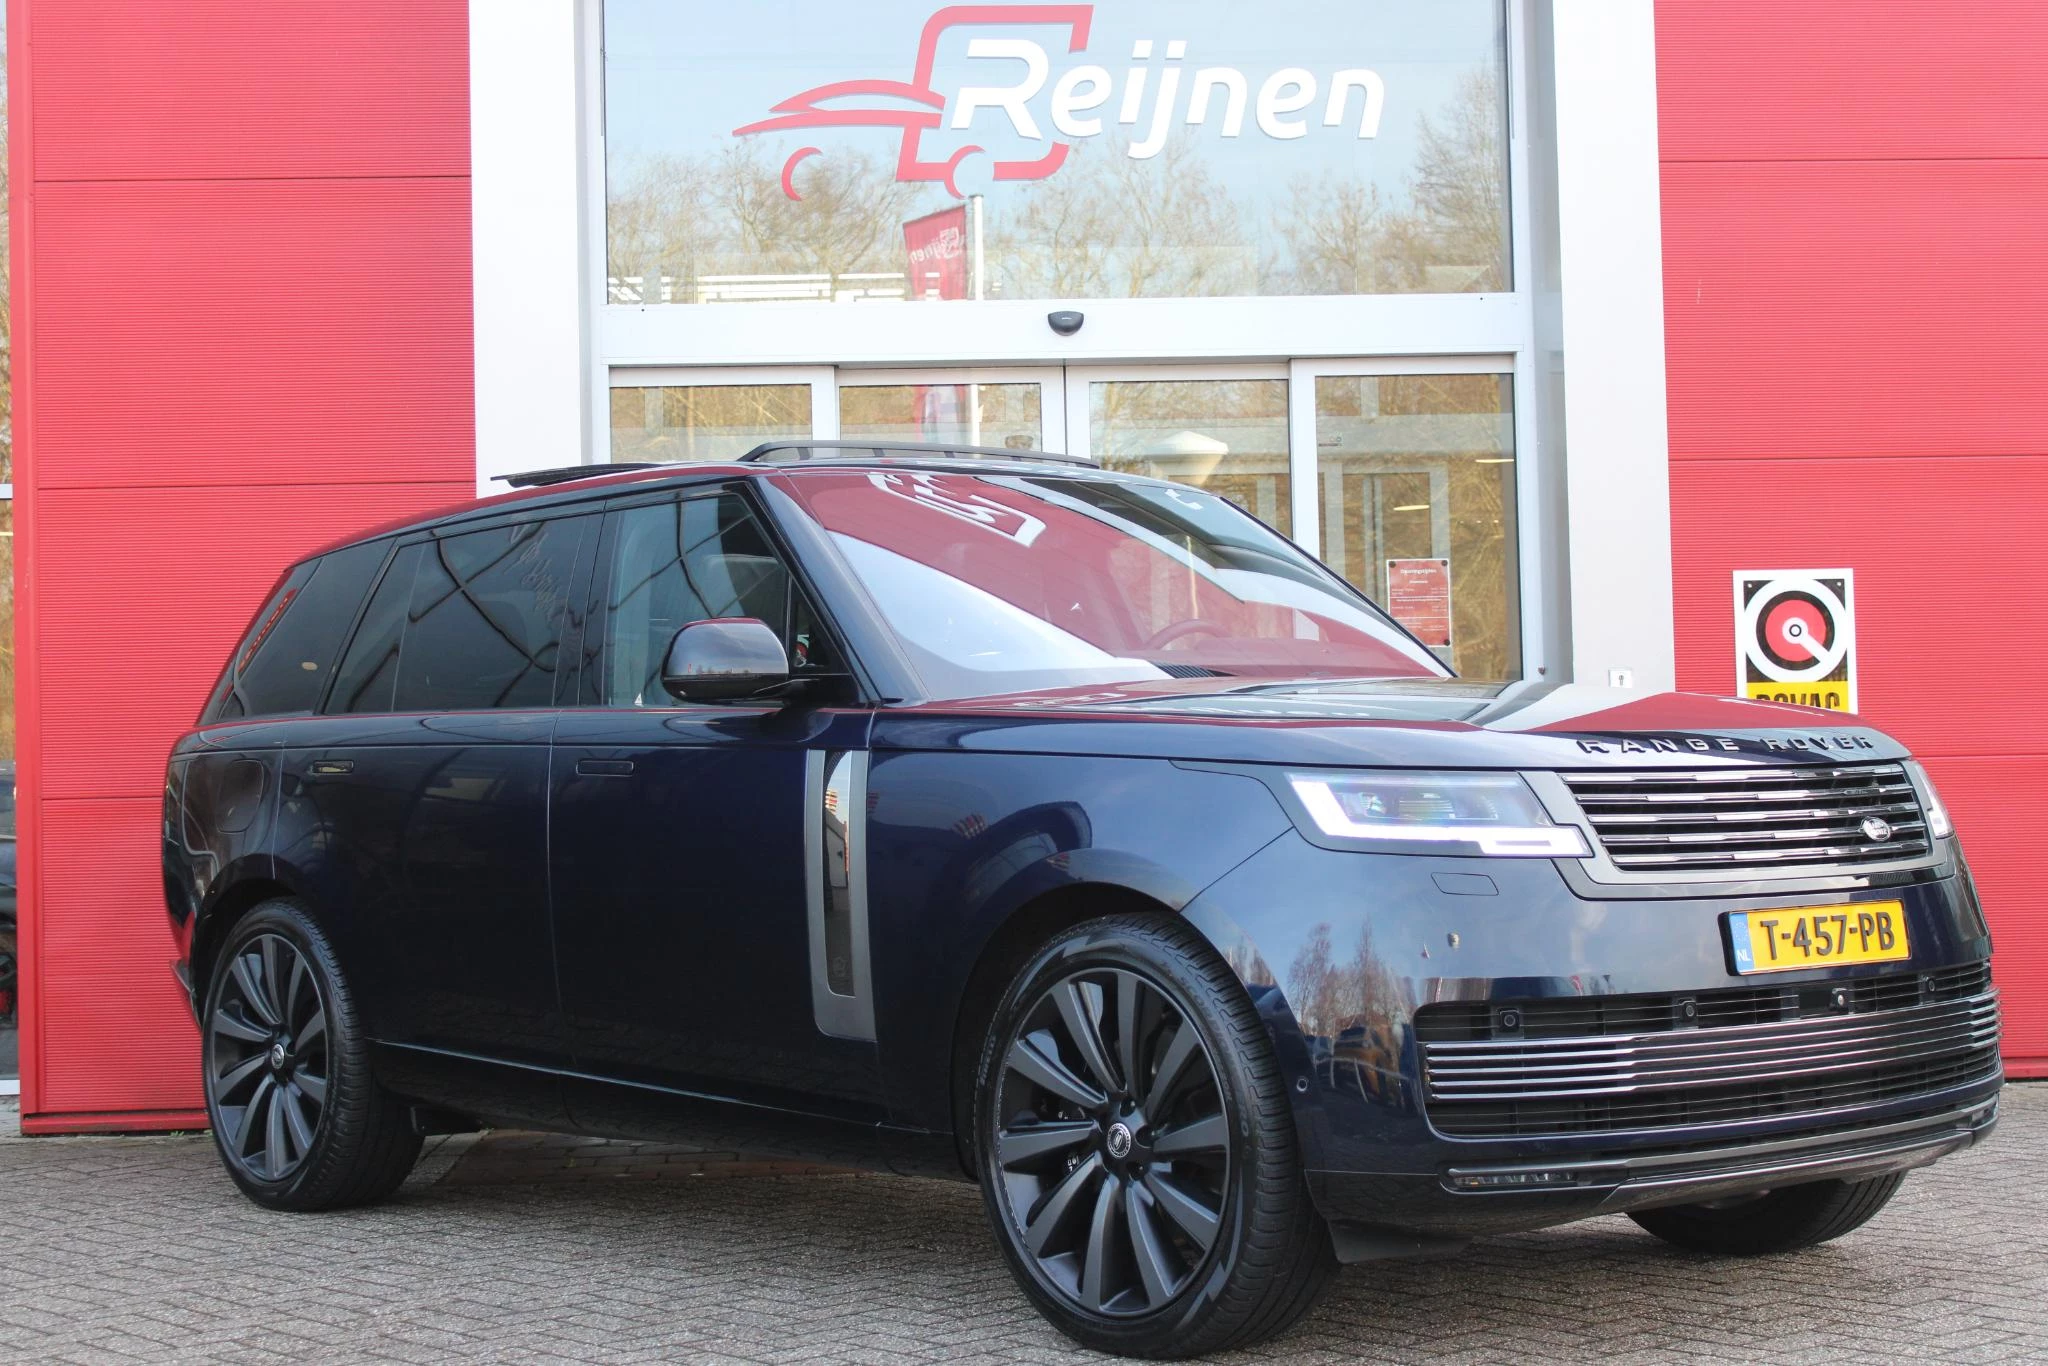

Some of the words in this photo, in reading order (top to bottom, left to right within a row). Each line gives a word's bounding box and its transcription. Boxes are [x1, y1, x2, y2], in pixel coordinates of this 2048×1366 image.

[950, 39, 1385, 159] Reijnen
[1576, 738, 1740, 754] RANGE
[1760, 735, 1874, 751] ROVER
[1760, 912, 1895, 961] T-457-PB
[1737, 950, 1752, 962] NL
